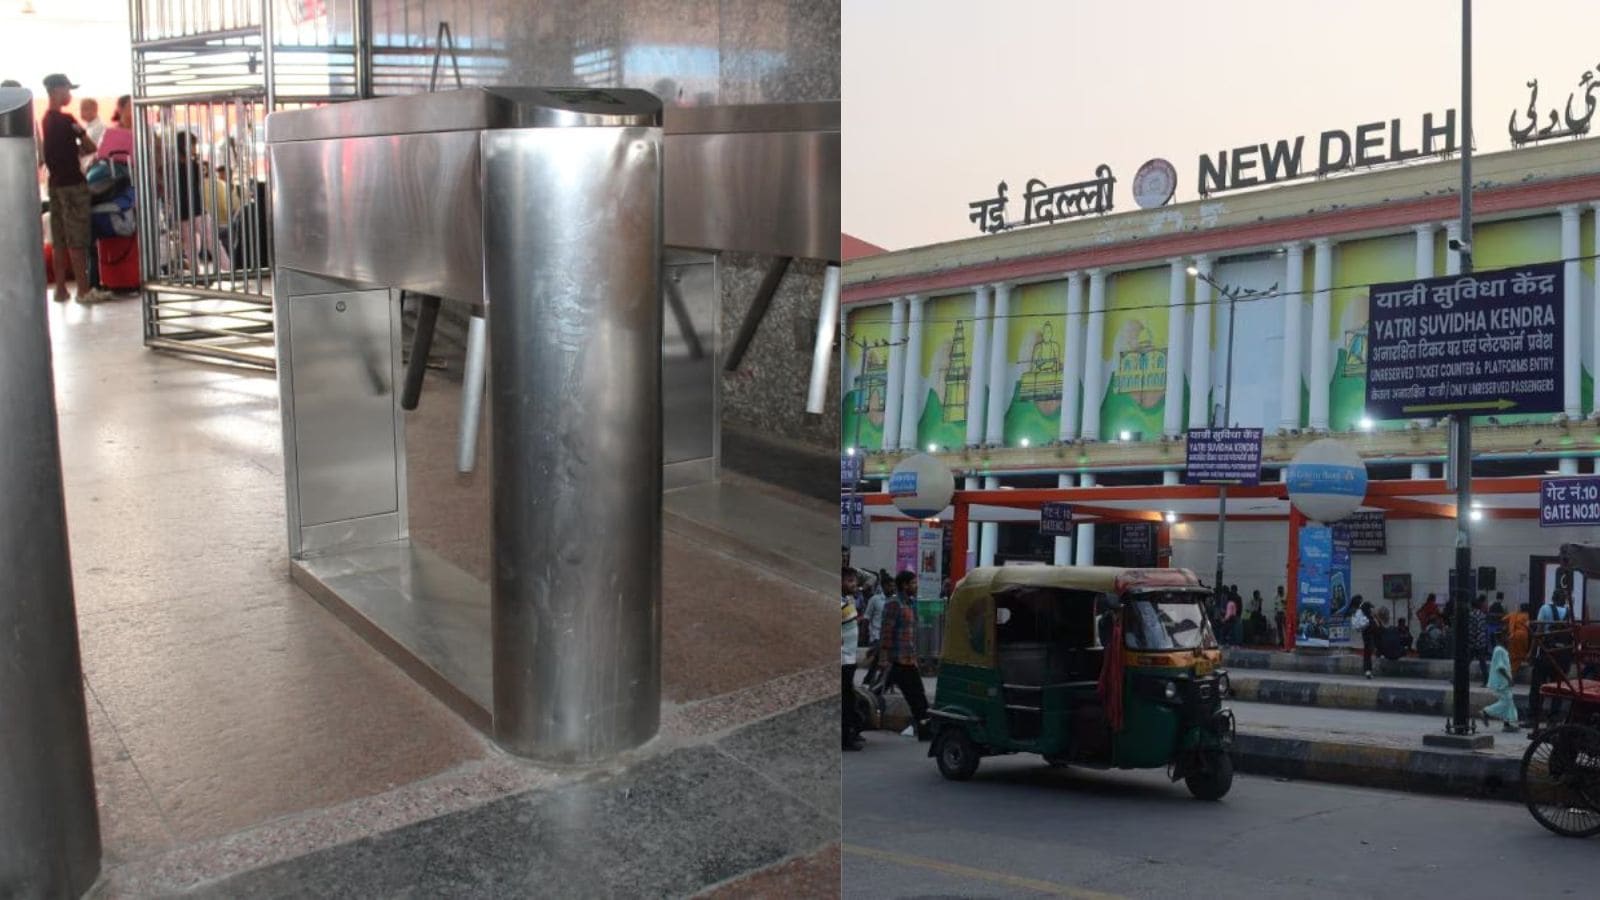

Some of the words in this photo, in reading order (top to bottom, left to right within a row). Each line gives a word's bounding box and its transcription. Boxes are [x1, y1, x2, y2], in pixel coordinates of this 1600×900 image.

[1198, 136, 1305, 193] NEW
[1316, 109, 1456, 173] DELH
[969, 180, 1009, 232] नई
[1023, 163, 1117, 224] दिल्ली
[1375, 283, 1428, 308] यात्री
[1432, 278, 1507, 309] सुविधा
[1510, 272, 1556, 295] केंद्र
[1374, 316, 1416, 340] YATRI
[1419, 310, 1487, 337] SUVIDHA
[1490, 304, 1556, 330] KENDRA
[1418, 338, 1445, 358] टिकट
[1370, 367, 1414, 382] UNRESERVED
[1415, 364, 1439, 379] TICKET
[1440, 362, 1474, 377] COUNTER
[1484, 358, 1528, 374] PLATFORMS
[1529, 356, 1554, 371] ENTRY
[1545, 482, 1567, 501] गेट
[1543, 504, 1570, 520] GATE
